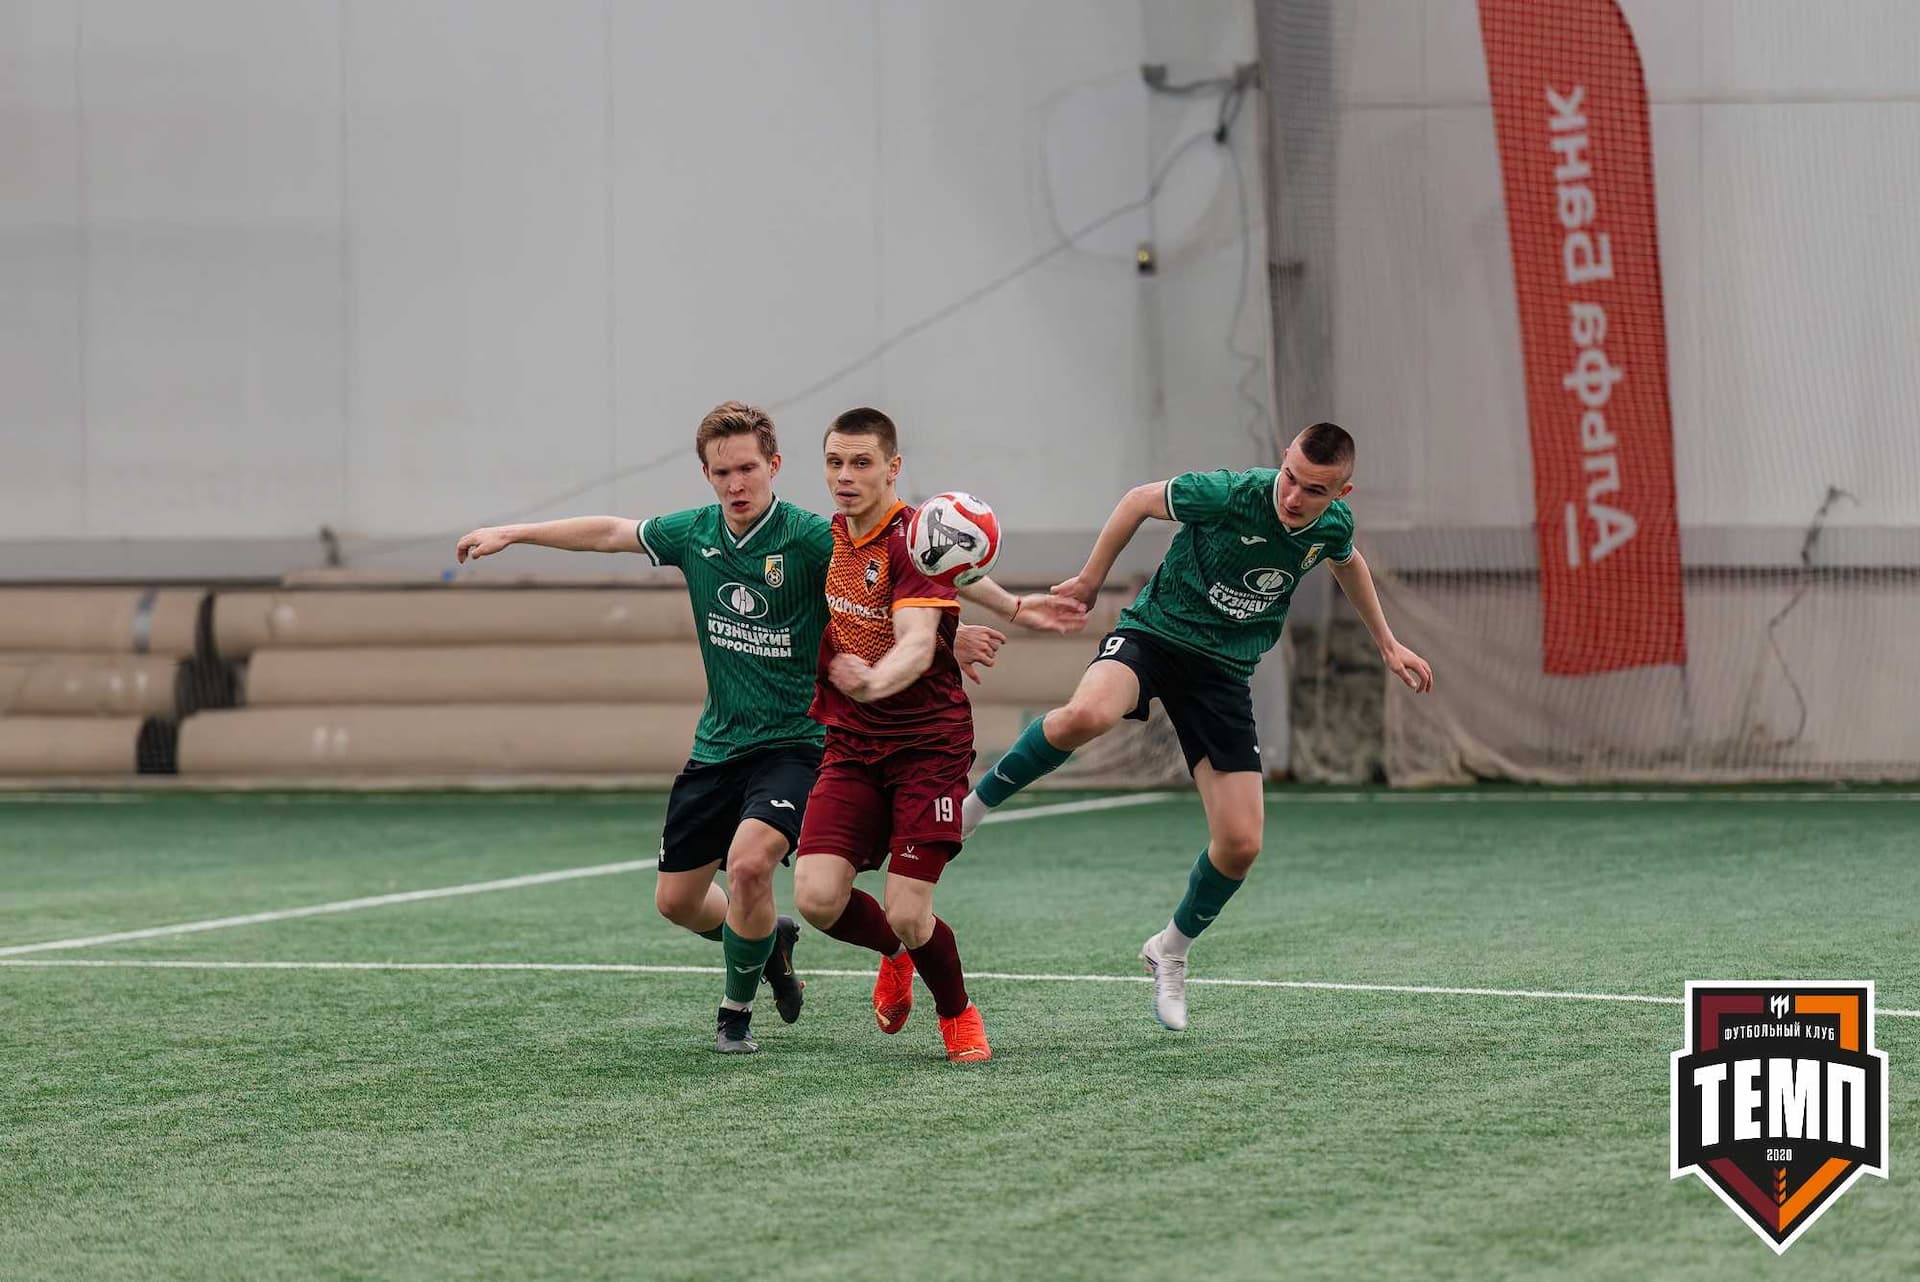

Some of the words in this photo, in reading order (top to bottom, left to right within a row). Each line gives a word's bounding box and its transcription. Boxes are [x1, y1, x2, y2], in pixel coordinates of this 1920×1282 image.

[1208, 584, 1274, 613] КУЗНЕЦ
[708, 618, 791, 647] КУЗНЕЦКИЕ
[710, 635, 792, 657] ФЕРРОСПЛАВЫ
[1100, 636, 1126, 658] 9
[933, 796, 954, 822] 19
